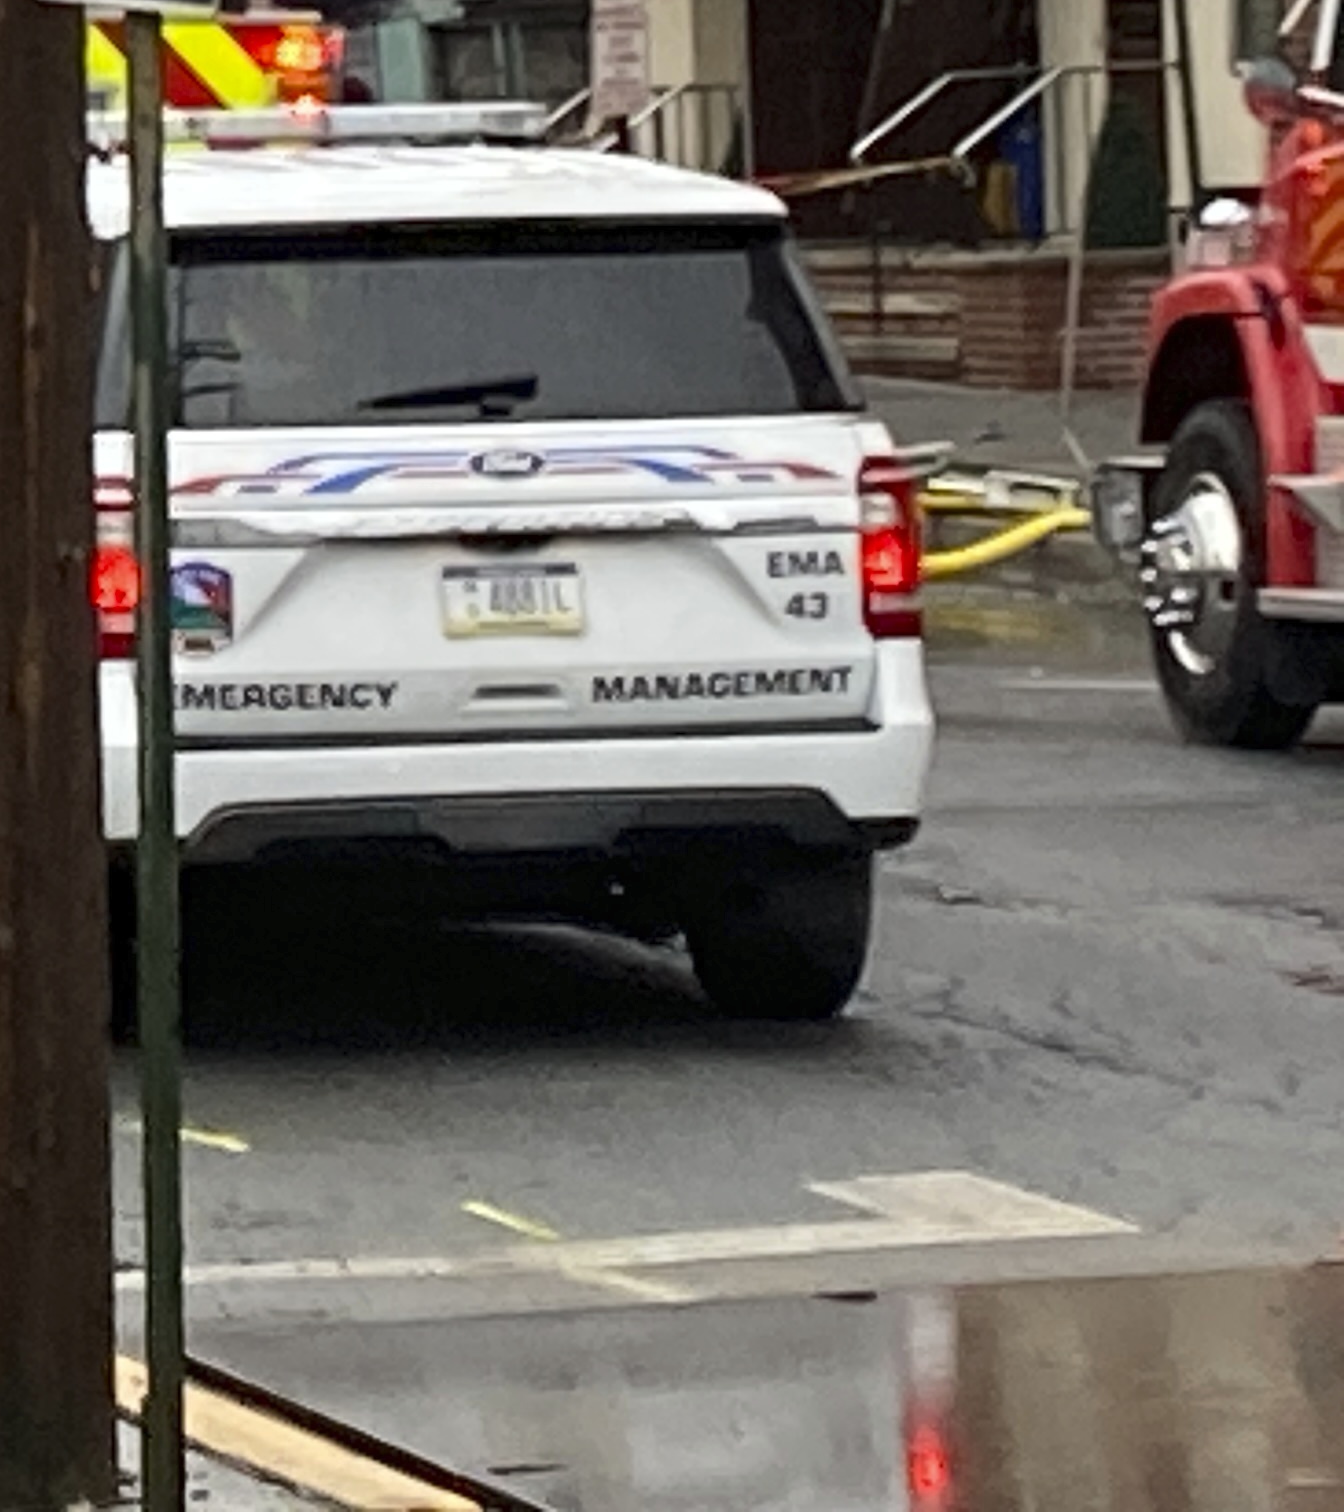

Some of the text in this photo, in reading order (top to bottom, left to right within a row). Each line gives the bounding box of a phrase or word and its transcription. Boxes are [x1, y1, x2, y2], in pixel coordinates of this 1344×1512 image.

[766, 550, 845, 579] EMA
[784, 591, 829, 620] 43
[592, 665, 852, 703] MANAGEMENT
